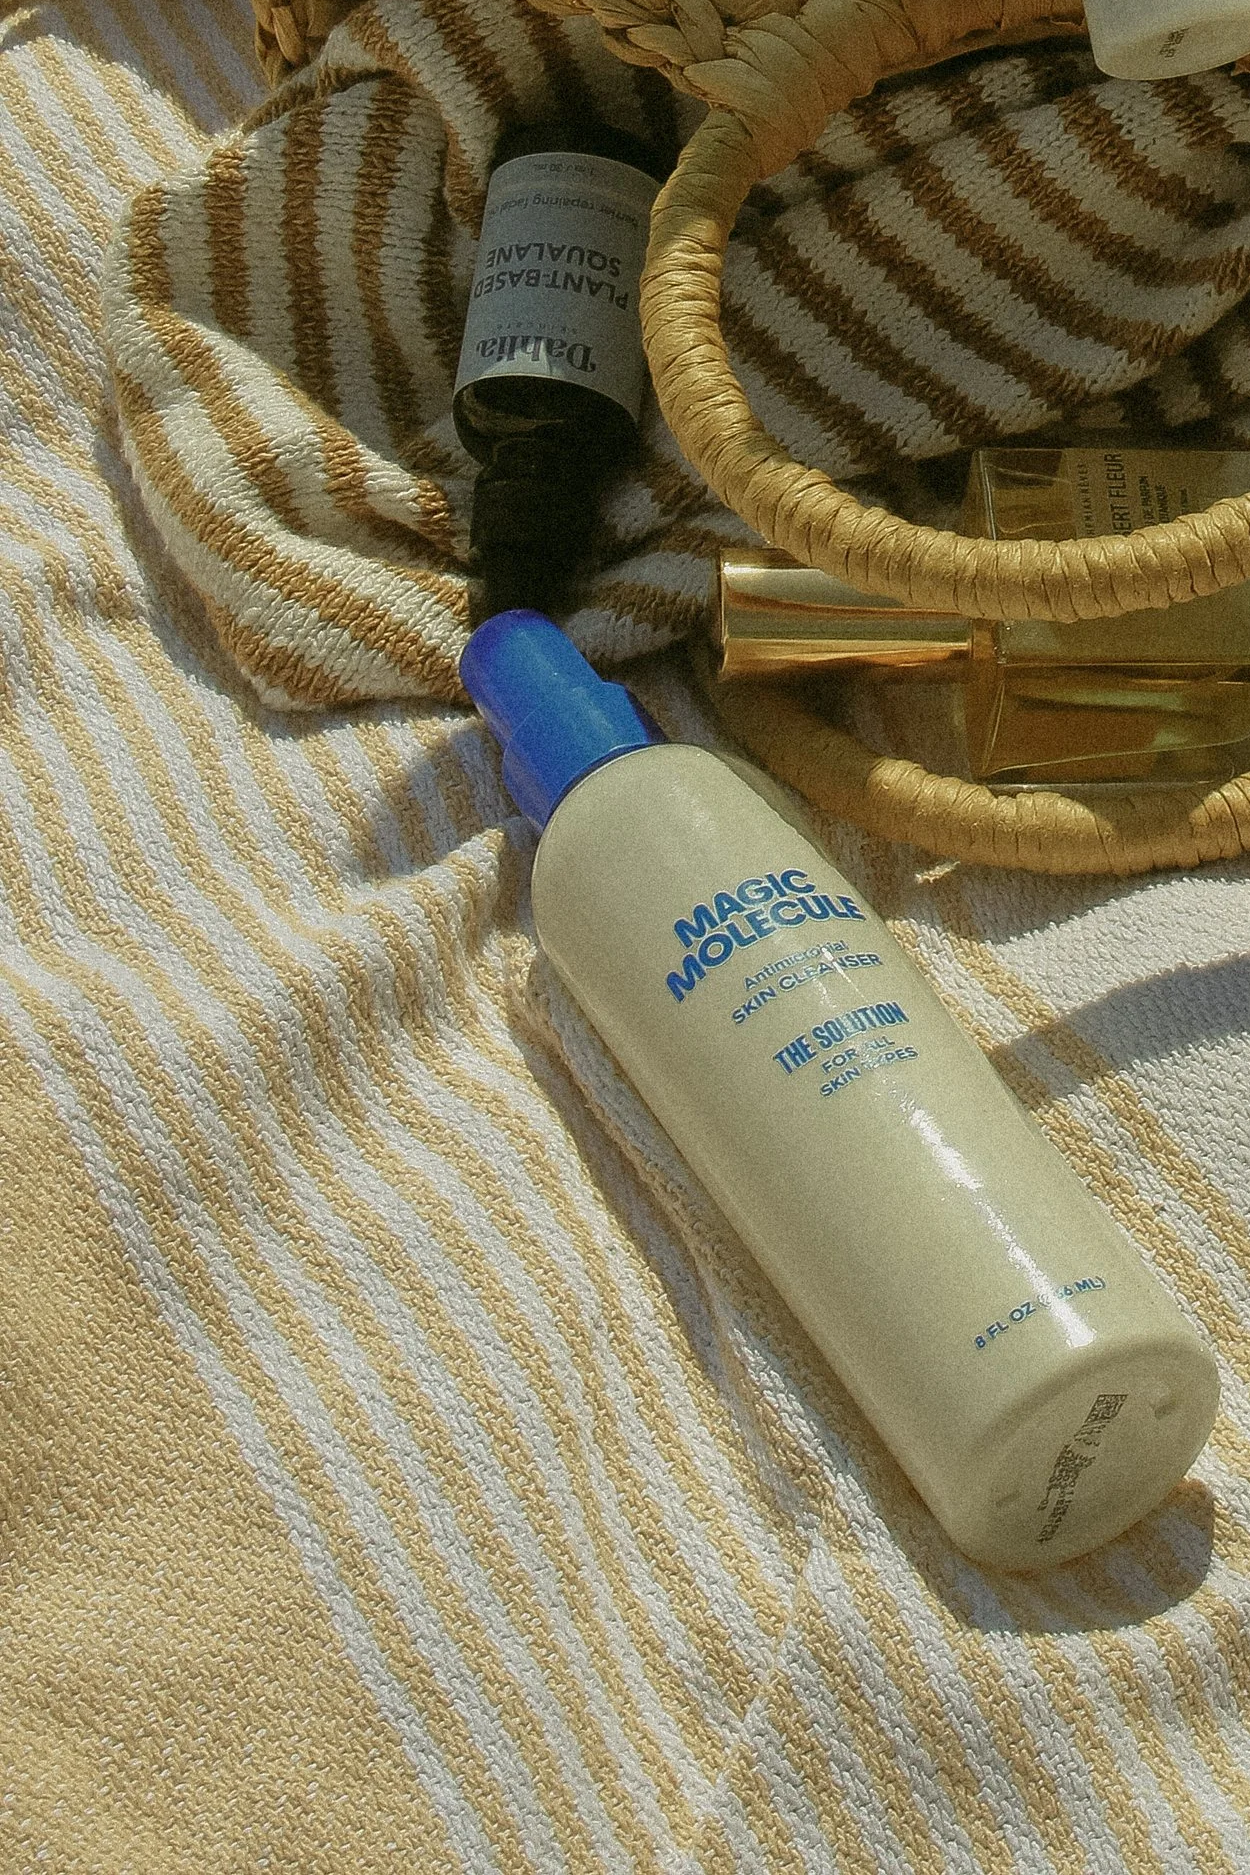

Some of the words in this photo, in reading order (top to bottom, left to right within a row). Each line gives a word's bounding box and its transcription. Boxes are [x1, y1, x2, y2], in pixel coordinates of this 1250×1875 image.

[485, 242, 621, 276] SQUALANE
[473, 268, 628, 310] PLANT-BASED
[476, 335, 597, 374] Dahlia
[1103, 453, 1128, 499] FLEUR
[1110, 503, 1132, 536] SERT
[674, 868, 816, 948] MAGIC
[666, 894, 867, 1003] MOLECULE
[732, 986, 777, 1024] SKIN
[779, 953, 883, 991] CLEANSER
[773, 1034, 817, 1075] THE
[812, 1001, 910, 1050] SOLUTION
[820, 1066, 861, 1097] SKIN
[822, 1047, 859, 1074] FOR
[975, 1334, 986, 1349] 8
[985, 1320, 1010, 1340] FL
[1009, 1301, 1036, 1323] OZ
[1075, 1275, 1106, 1293] ML)
